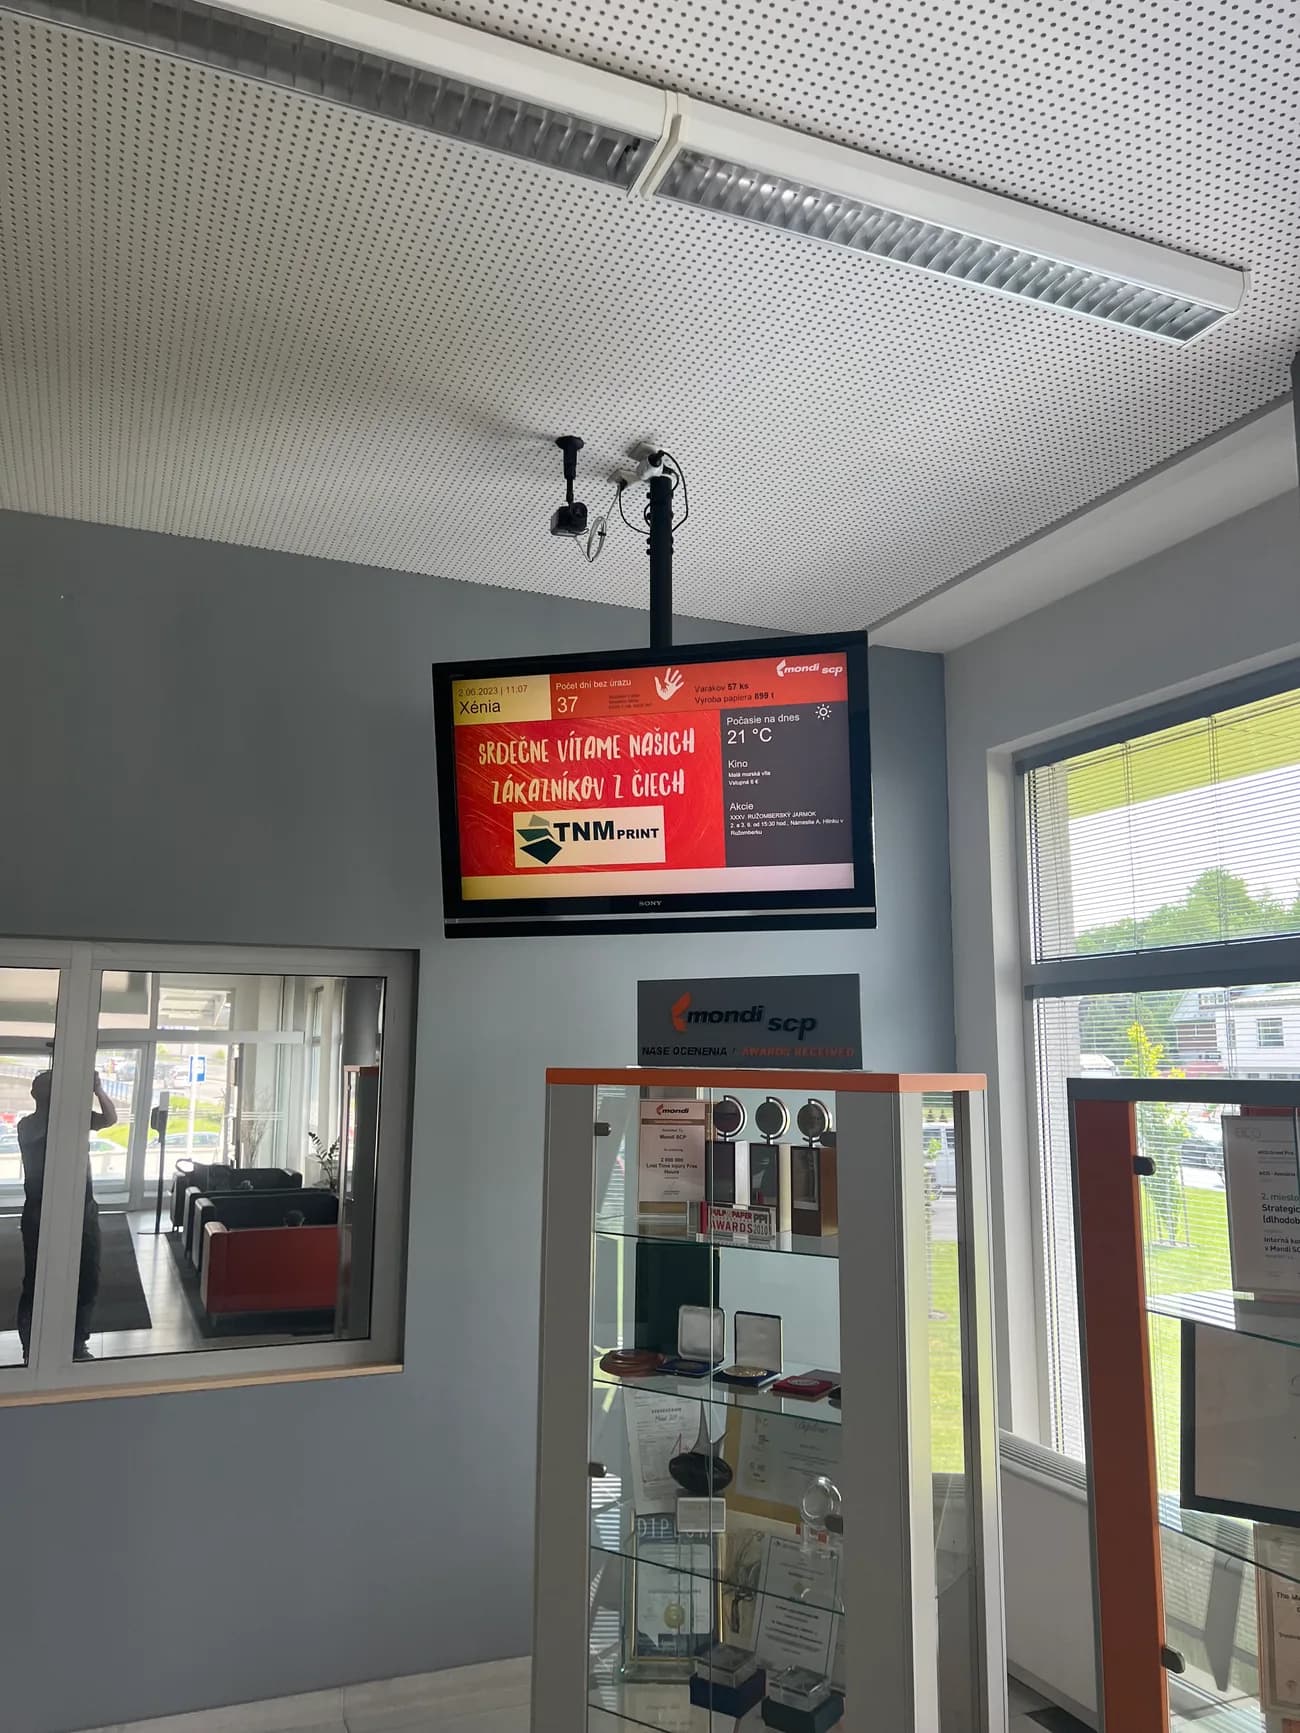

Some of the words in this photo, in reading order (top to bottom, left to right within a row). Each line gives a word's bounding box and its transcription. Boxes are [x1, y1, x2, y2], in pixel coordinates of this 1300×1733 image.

[784, 663, 820, 673] mondi
[822, 666, 843, 677] scp
[594, 680, 608, 688] bez
[728, 682, 737, 690] 57
[739, 682, 749, 690] ks
[557, 696, 578, 713] 37
[724, 694, 752, 704] papiera
[459, 700, 501, 715] Xénia
[726, 714, 762, 726] Počasie
[764, 716, 775, 724] na
[777, 714, 800, 722] dnes
[727, 730, 745, 744] 21
[752, 727, 772, 742] °C
[479, 736, 549, 766] SRDEČNE
[558, 730, 621, 762] VÍTAME
[629, 727, 695, 758] NAŠICH
[728, 760, 748, 768] Kino
[492, 770, 605, 804] ZÁKAZNÍKOV
[613, 774, 624, 799] Z
[632, 768, 685, 798] ČIECH
[730, 802, 754, 811] Akcie
[553, 820, 614, 842] TNM
[617, 828, 660, 840] PRINT
[686, 1004, 764, 1024] mondi
[768, 1015, 818, 1040] scp
[672, 1046, 728, 1056] OCENENIA
[732, 1210, 752, 1220] PAPER
